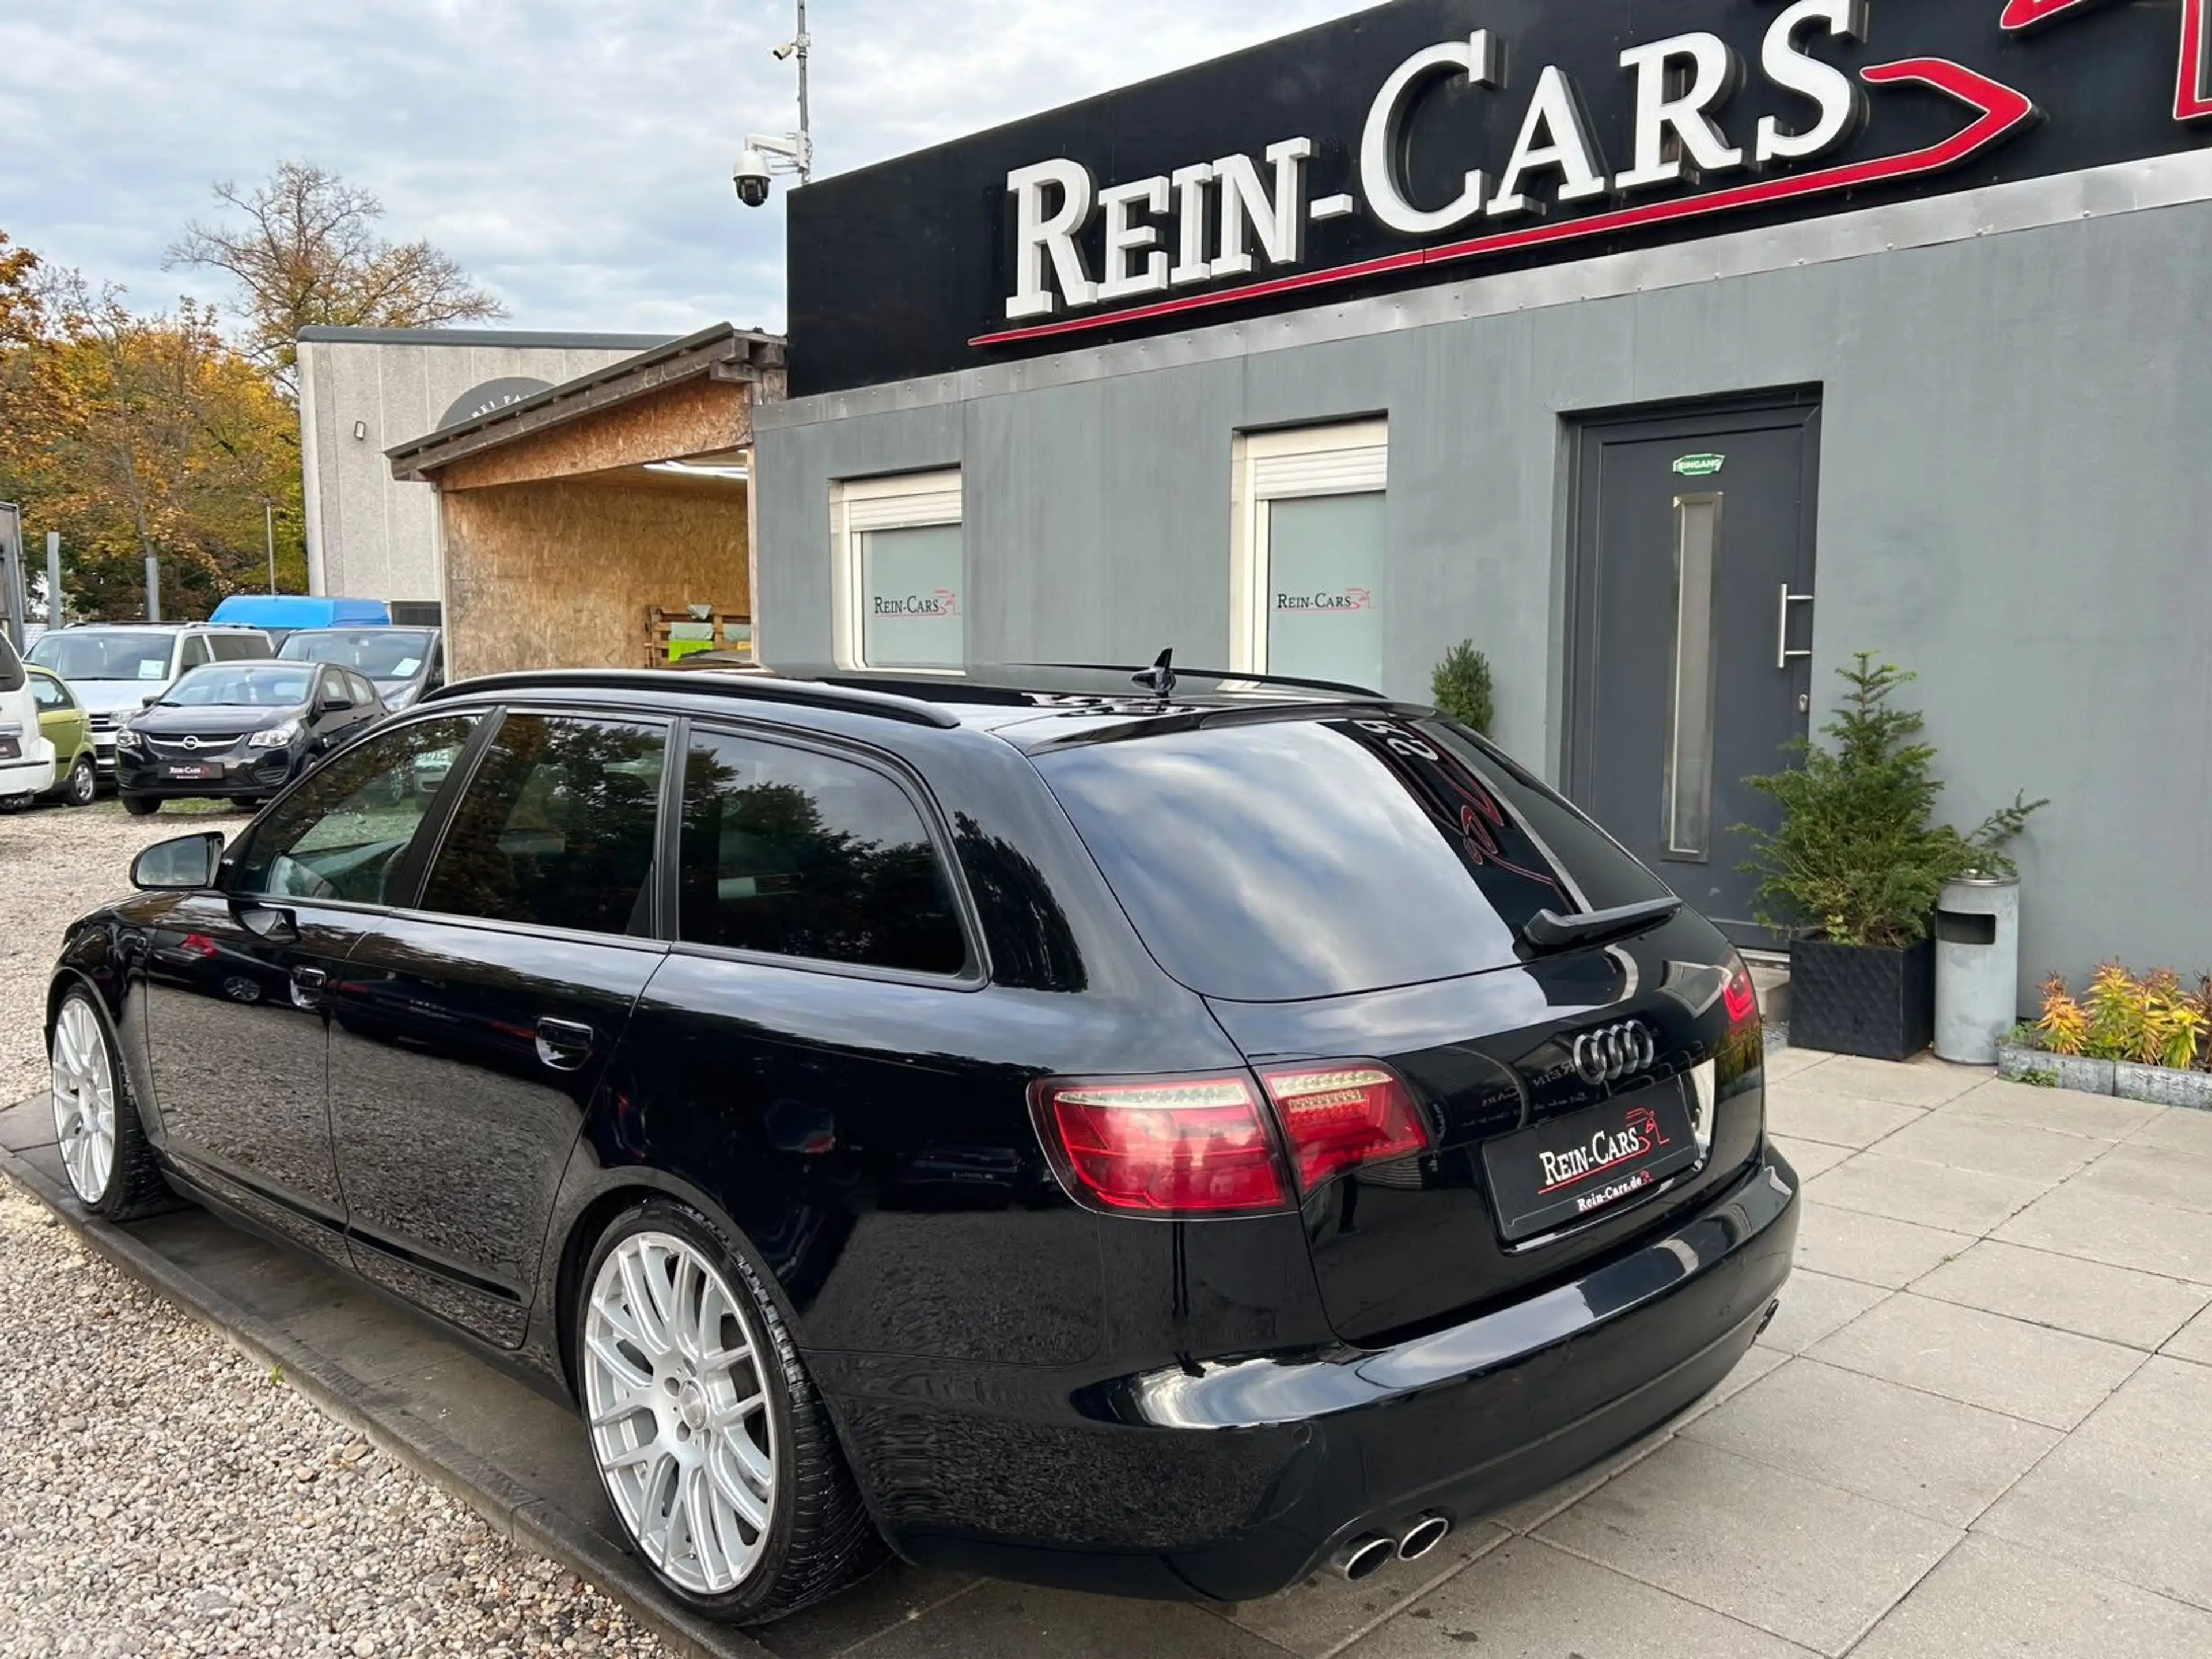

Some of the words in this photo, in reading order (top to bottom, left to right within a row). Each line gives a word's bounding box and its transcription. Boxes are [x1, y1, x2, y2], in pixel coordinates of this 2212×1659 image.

[1006, 0, 1866, 319] REIN-CARS
[874, 596, 938, 613] REIN-CARS
[1277, 592, 1351, 609] REIN-CARS
[1539, 1127, 1640, 1185] REIN-CARS
[1577, 1176, 1642, 1212] Rein-Cars.de
